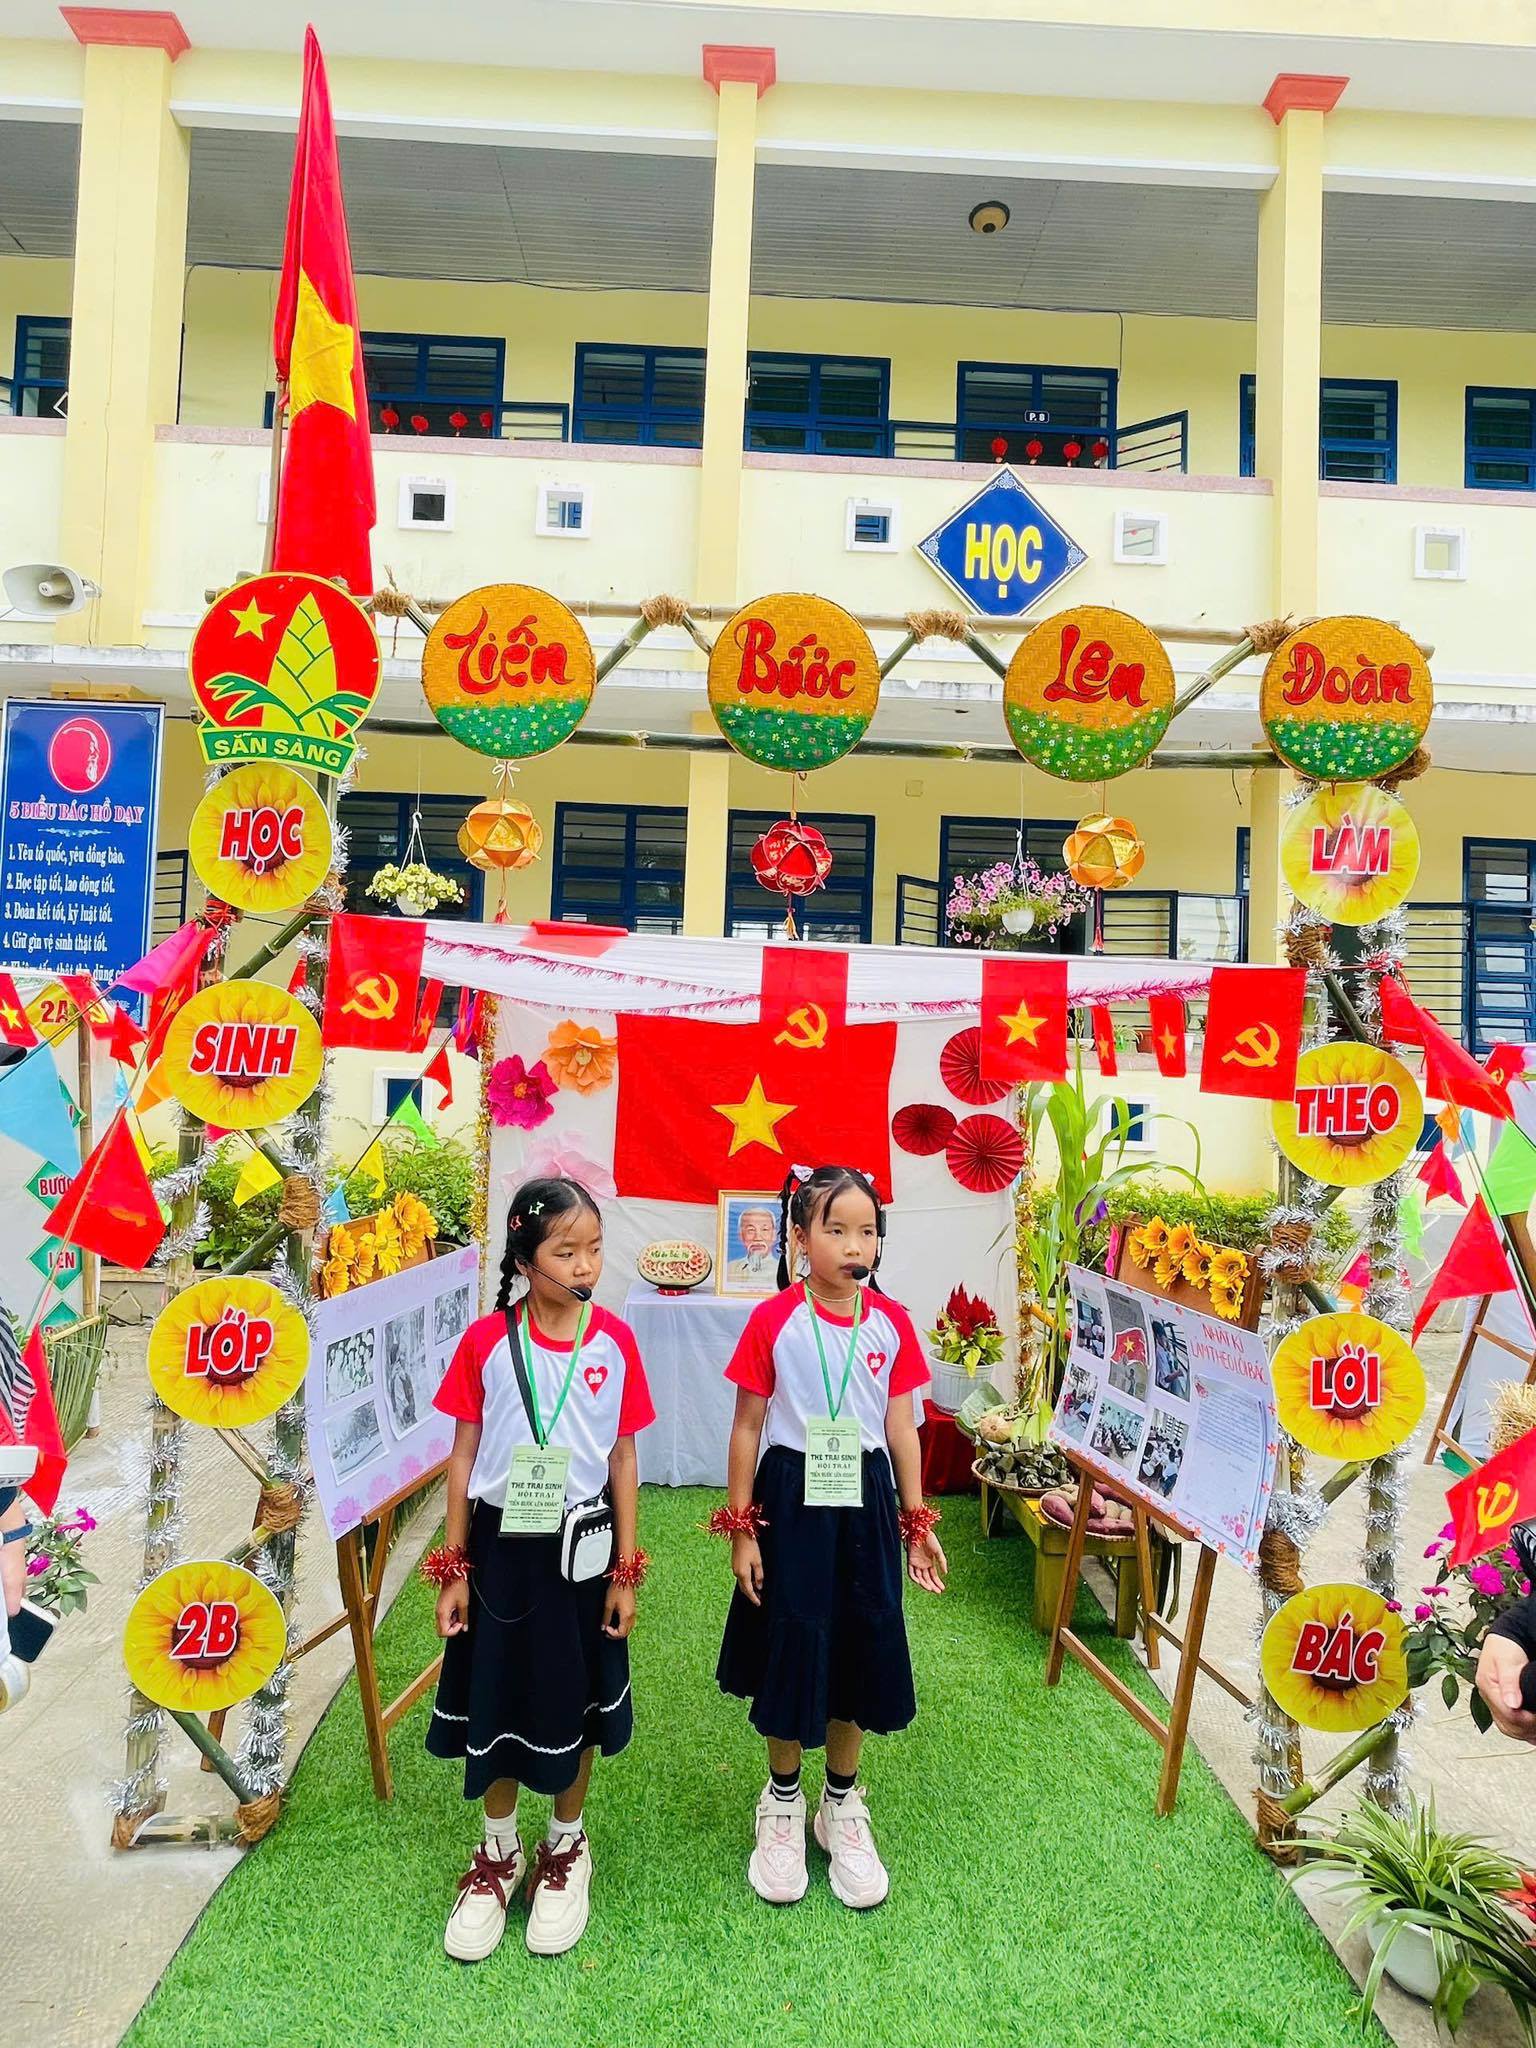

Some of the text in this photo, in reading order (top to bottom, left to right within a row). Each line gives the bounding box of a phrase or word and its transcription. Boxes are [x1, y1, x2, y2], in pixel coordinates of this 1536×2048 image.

[964, 523, 1043, 598] HỌC
[444, 606, 1415, 708] Tiến Bước Lên Đoàn
[213, 732, 342, 768] SẴN SÀNG
[9, 794, 145, 827] 5 ĐIỀU BÁC HỒ DẠY
[9, 843, 16, 860] 1.
[17, 843, 33, 861] Yêu
[69, 846, 85, 866] yêu
[219, 806, 305, 876] HỌC
[1309, 813, 1392, 877] LÀM
[6, 872, 115, 896] 2. Học tập tốt, lao động tốt.
[4, 902, 12, 919] 3.
[13, 902, 35, 920] Đoàn
[36, 901, 51, 921] kết
[52, 901, 66, 924] tốt,
[80, 904, 98, 925] luật
[99, 903, 113, 922] tốt.
[3, 931, 108, 954] 4. Giữ gìn vệ sinh thật tốt.
[40, 1000, 69, 1023] 2A
[190, 1022, 300, 1077] SINH
[1294, 1083, 1400, 1137] THEO
[184, 1306, 273, 1377] LỚP
[1310, 1343, 1382, 1411] LỜI
[170, 1601, 240, 1661] 2B
[1292, 1612, 1385, 1686] BÁC
